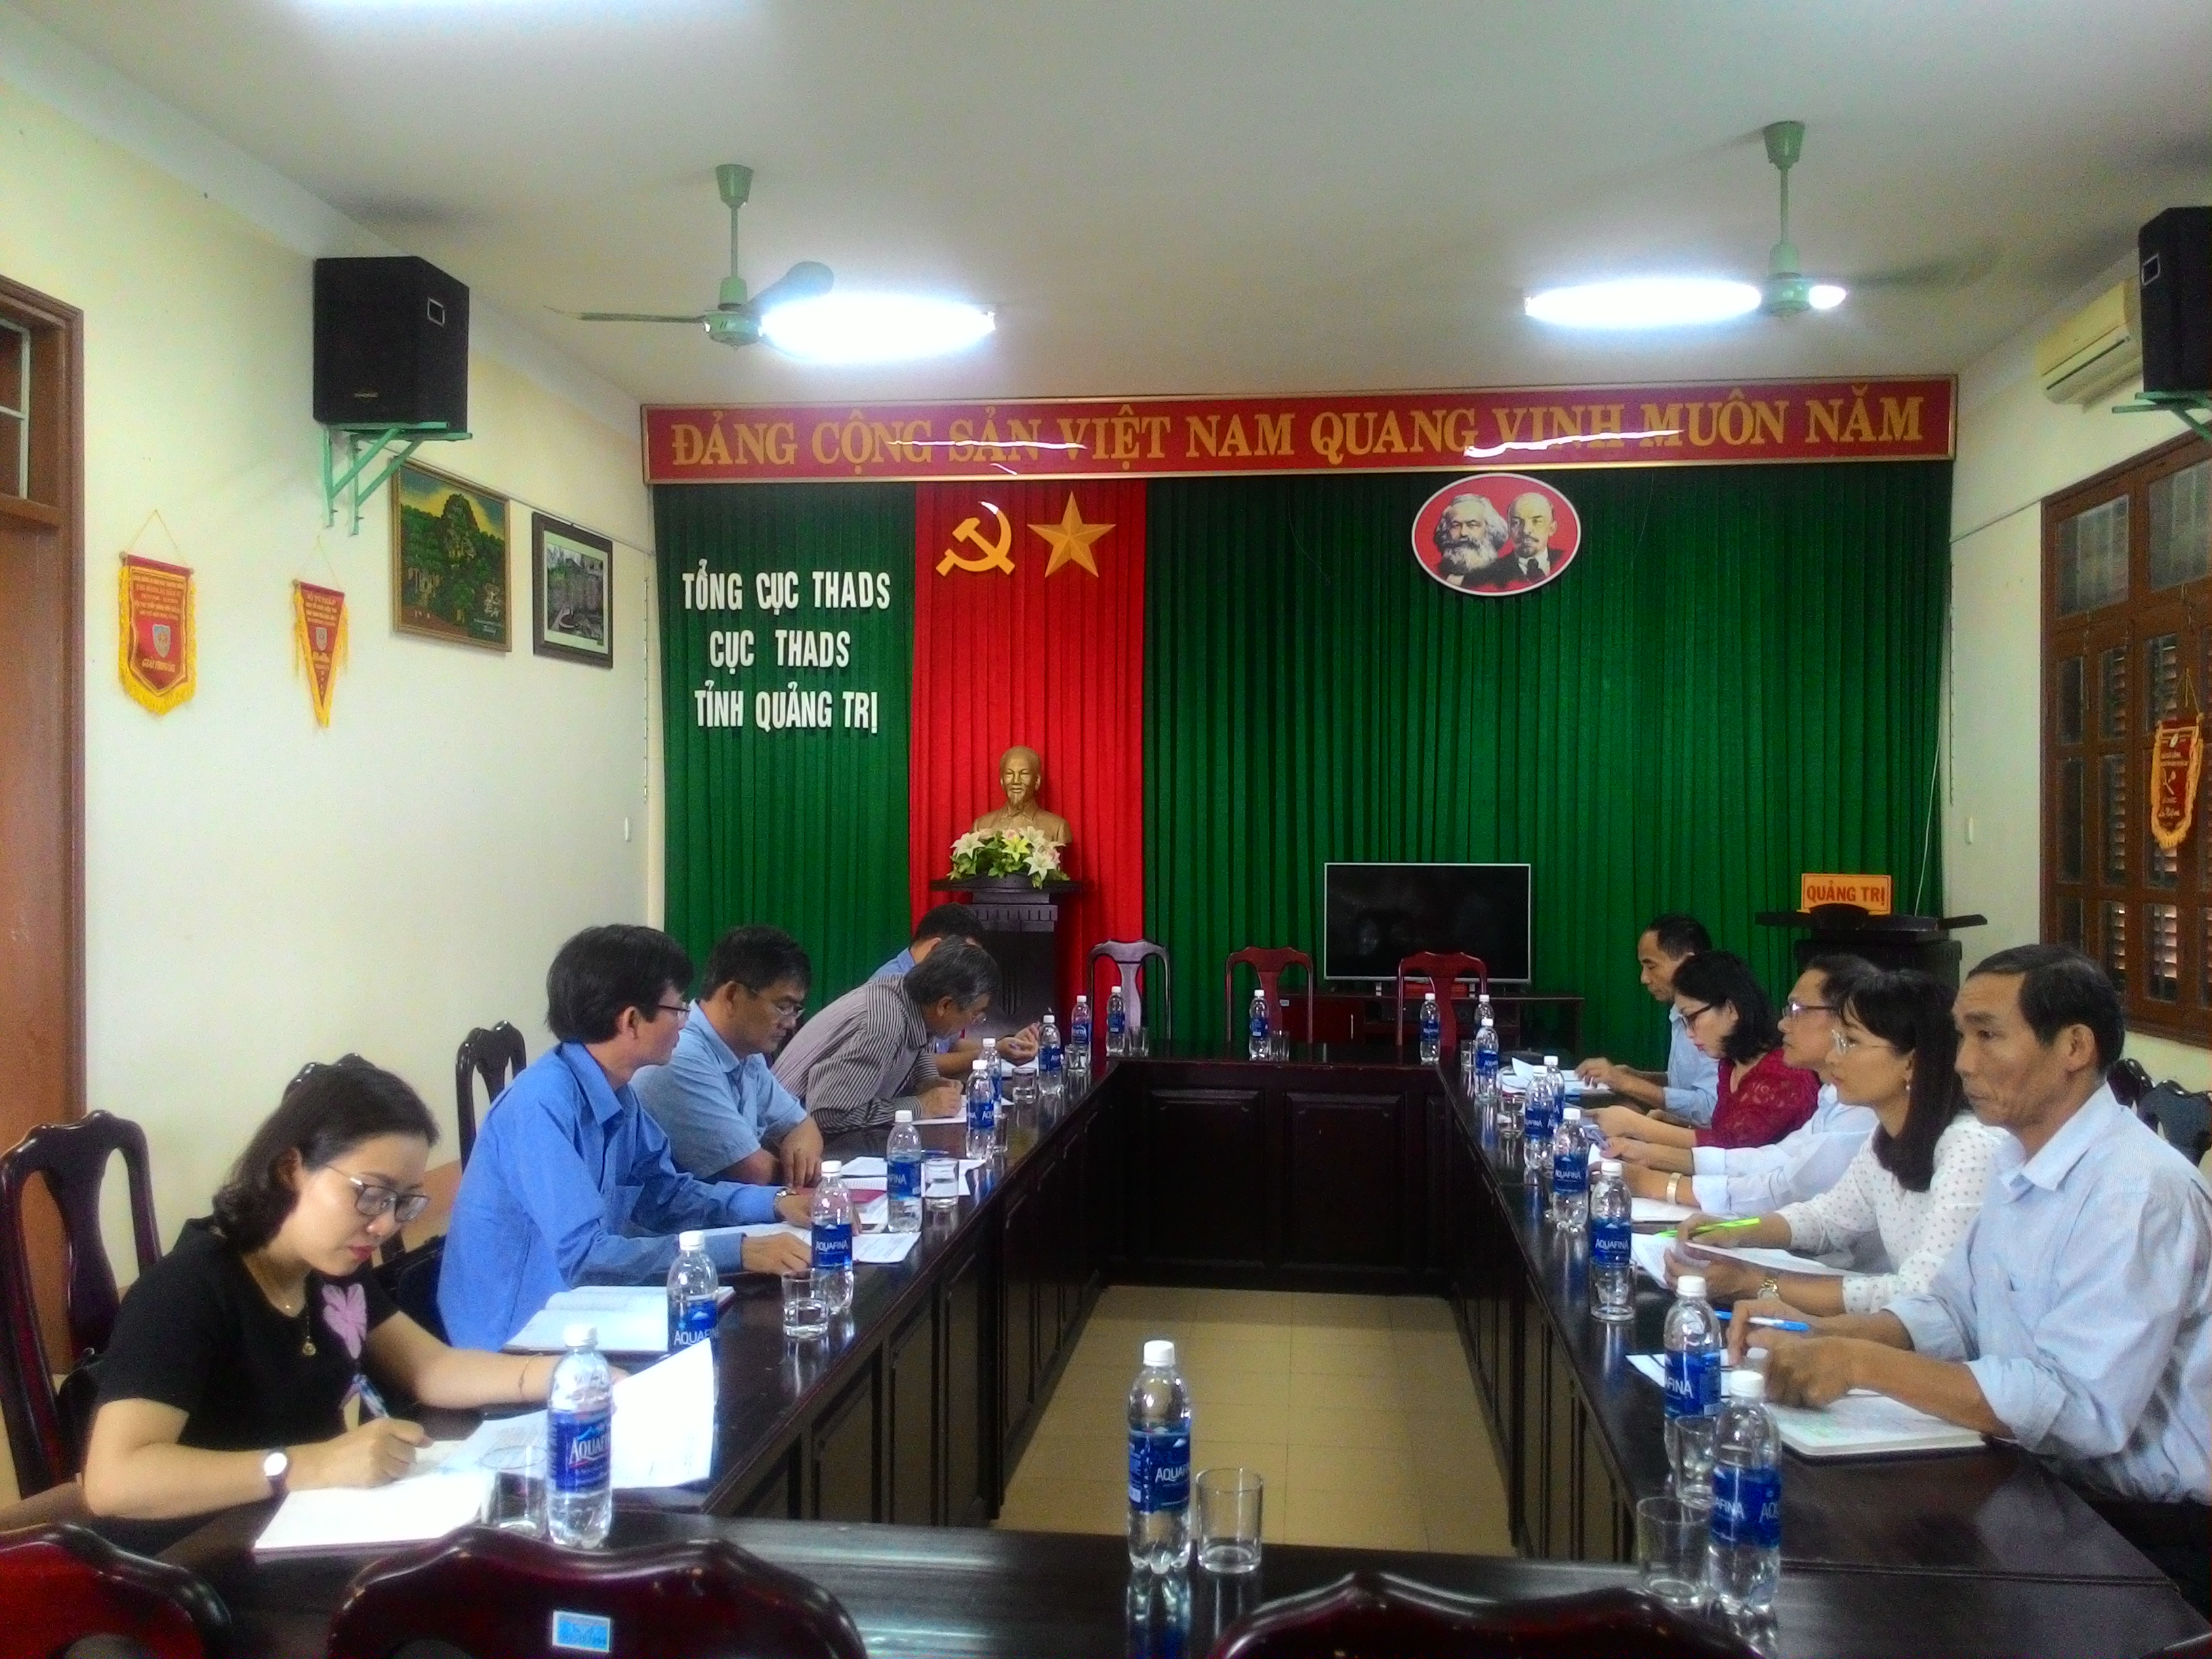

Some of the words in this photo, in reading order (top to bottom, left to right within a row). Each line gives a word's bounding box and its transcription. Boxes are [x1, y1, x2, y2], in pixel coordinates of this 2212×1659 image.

[671, 410, 798, 465] ĐẢNG
[811, 408, 933, 474] CỘNG
[948, 405, 1042, 462] SẢN
[1057, 404, 1171, 470] VIỆT
[1186, 411, 1295, 459] NAM
[1310, 407, 1479, 466] QUANG
[1492, 405, 1625, 449] VINH
[1640, 387, 1786, 447] MUÔN
[1804, 385, 1923, 444] NĂM
[682, 558, 743, 610] TỔNG
[756, 571, 799, 615] CỤC
[812, 571, 891, 609] THADS
[710, 630, 755, 675] CỤC
[775, 630, 851, 668] THADS
[694, 680, 744, 727] TỈNH
[755, 681, 833, 733] QUẢNG
[842, 691, 878, 734] TRỊ
[1806, 880, 1856, 903] QUẢNG
[1861, 886, 1885, 906] TRỊ
[815, 1240, 849, 1252] AQUAFINA
[1595, 1238, 1629, 1250] AQUAFINA
[673, 1328, 711, 1346] AQUAF
